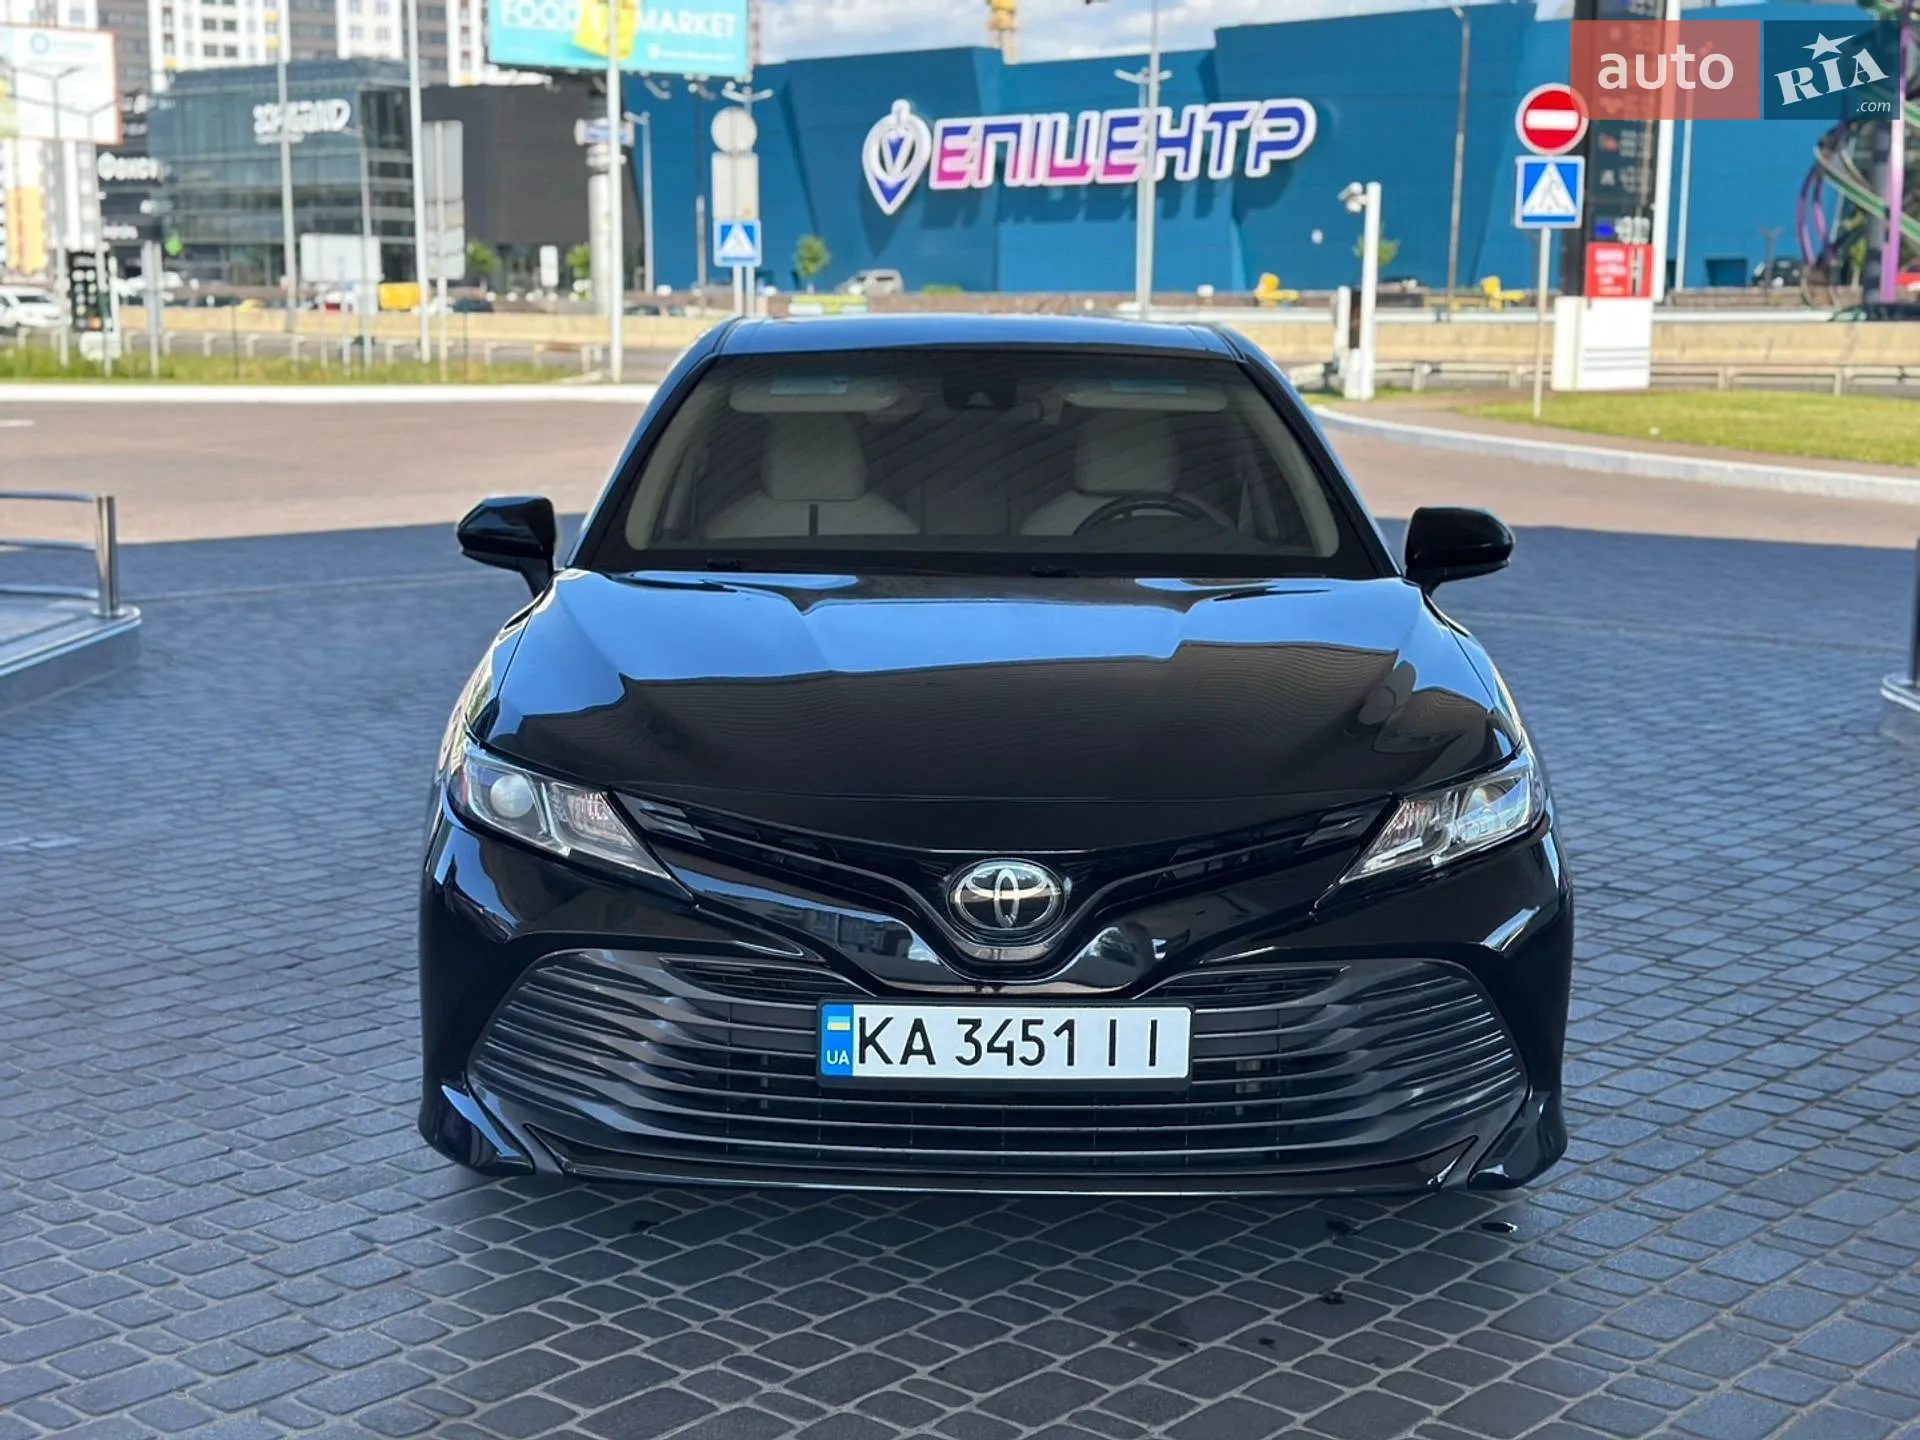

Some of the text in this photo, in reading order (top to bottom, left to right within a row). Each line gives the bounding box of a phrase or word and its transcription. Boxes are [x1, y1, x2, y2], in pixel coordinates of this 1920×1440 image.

[638, 8, 737, 38] MARKET
[929, 98, 1317, 191] ЕПІЦЕНТР
[826, 1050, 850, 1066] UA
[858, 1016, 936, 1066] KA
[955, 1018, 1075, 1067] 3451
